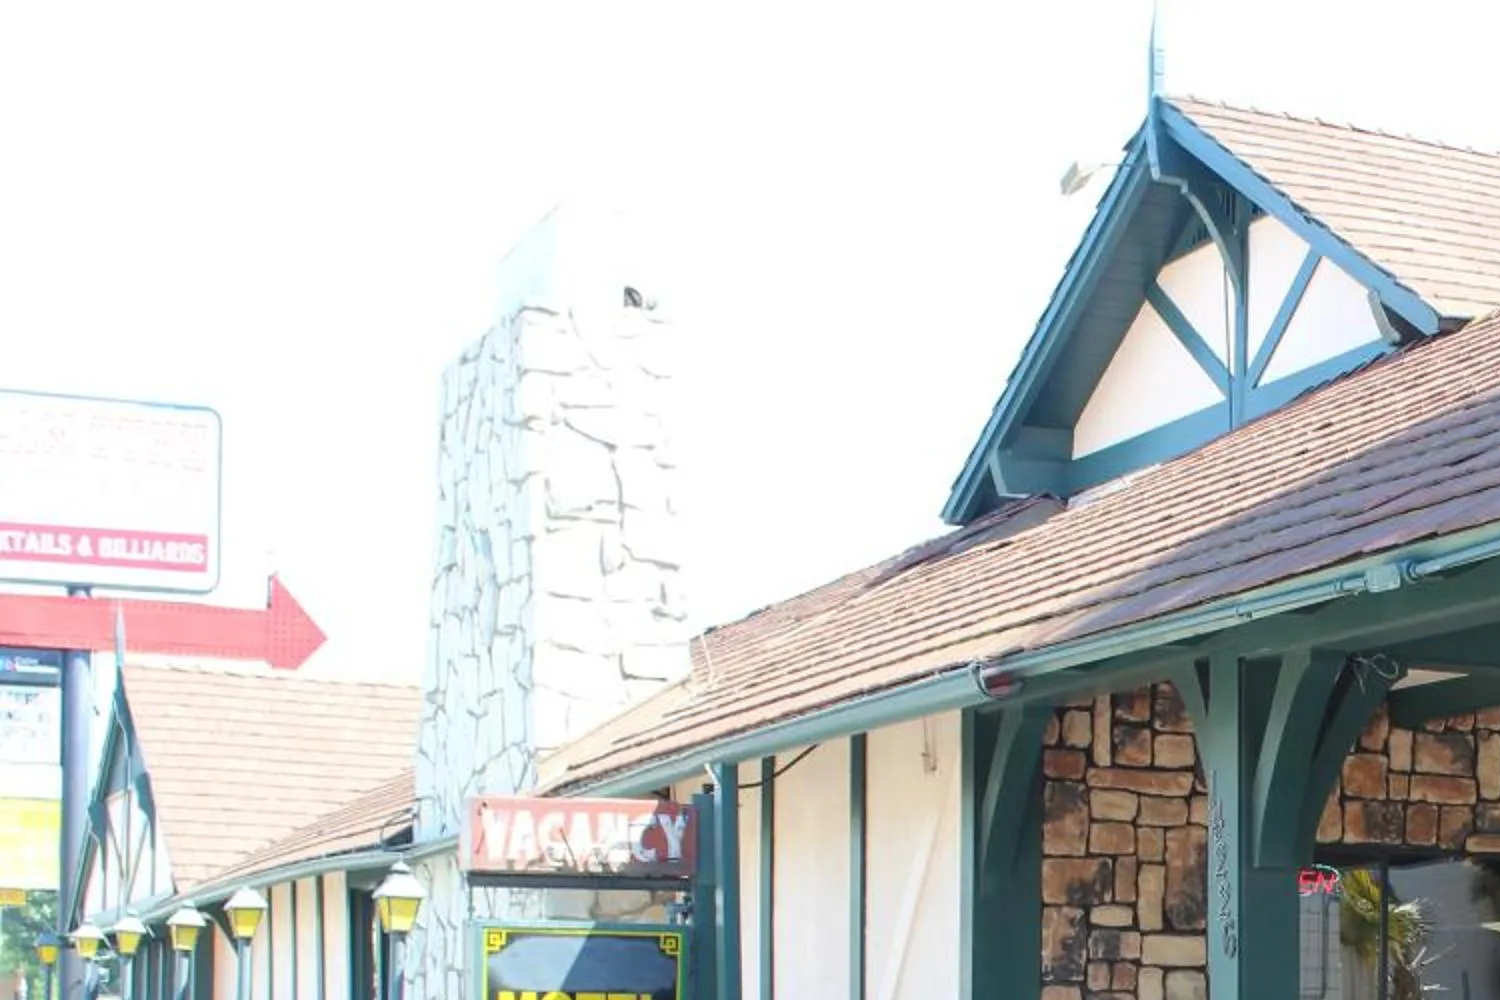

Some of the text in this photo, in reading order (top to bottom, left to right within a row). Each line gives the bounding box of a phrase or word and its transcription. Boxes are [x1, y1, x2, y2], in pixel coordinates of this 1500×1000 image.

[77, 534, 94, 558] &
[100, 537, 205, 562] BILLIARDS
[483, 809, 690, 863] VACANCY
